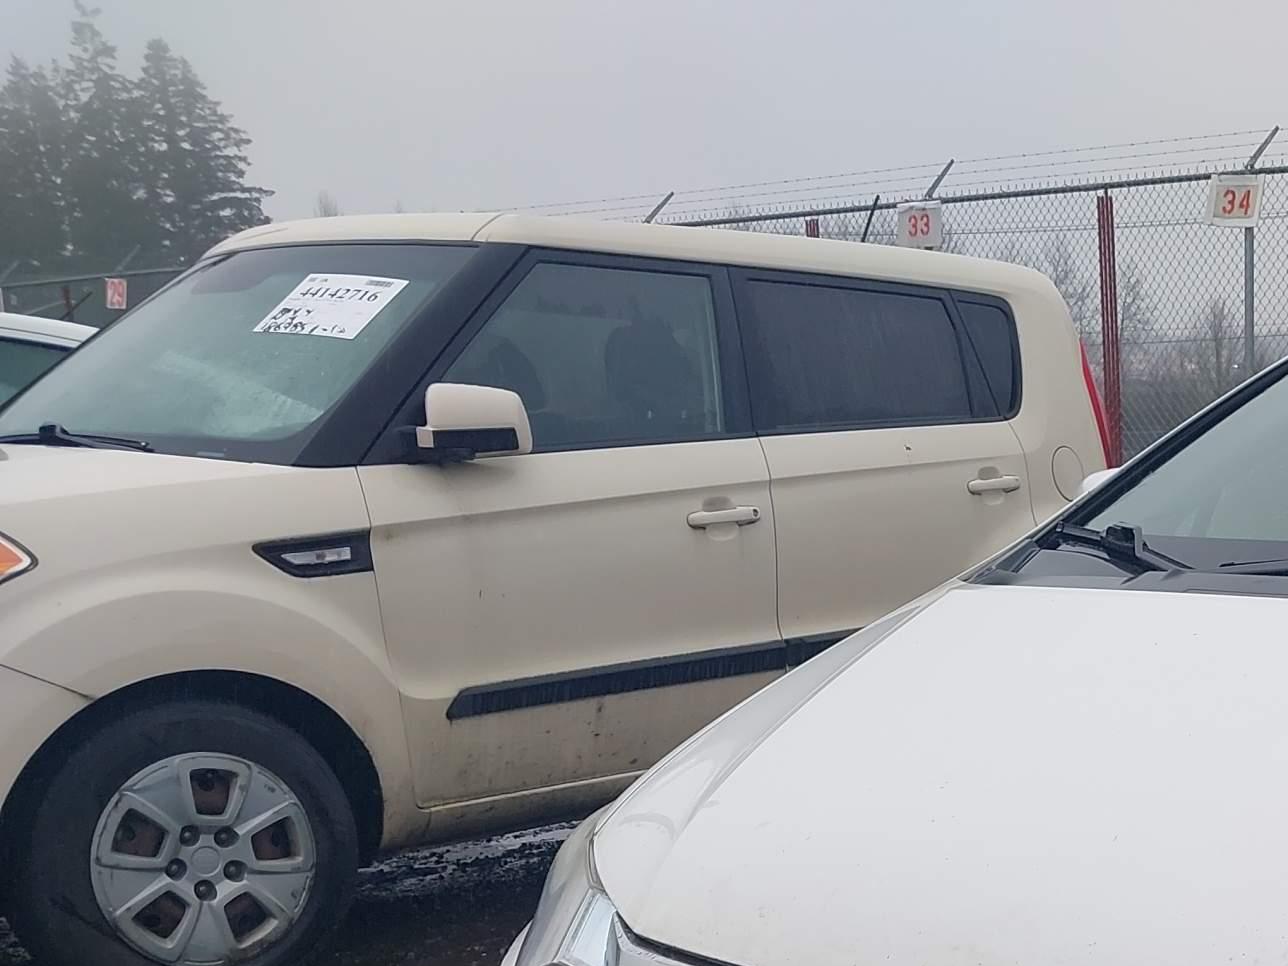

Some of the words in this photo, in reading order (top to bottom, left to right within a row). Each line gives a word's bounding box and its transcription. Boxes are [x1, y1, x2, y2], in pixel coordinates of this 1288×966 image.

[1222, 189, 1251, 215] 34
[908, 213, 930, 236] 33
[300, 287, 379, 302] 44142716
